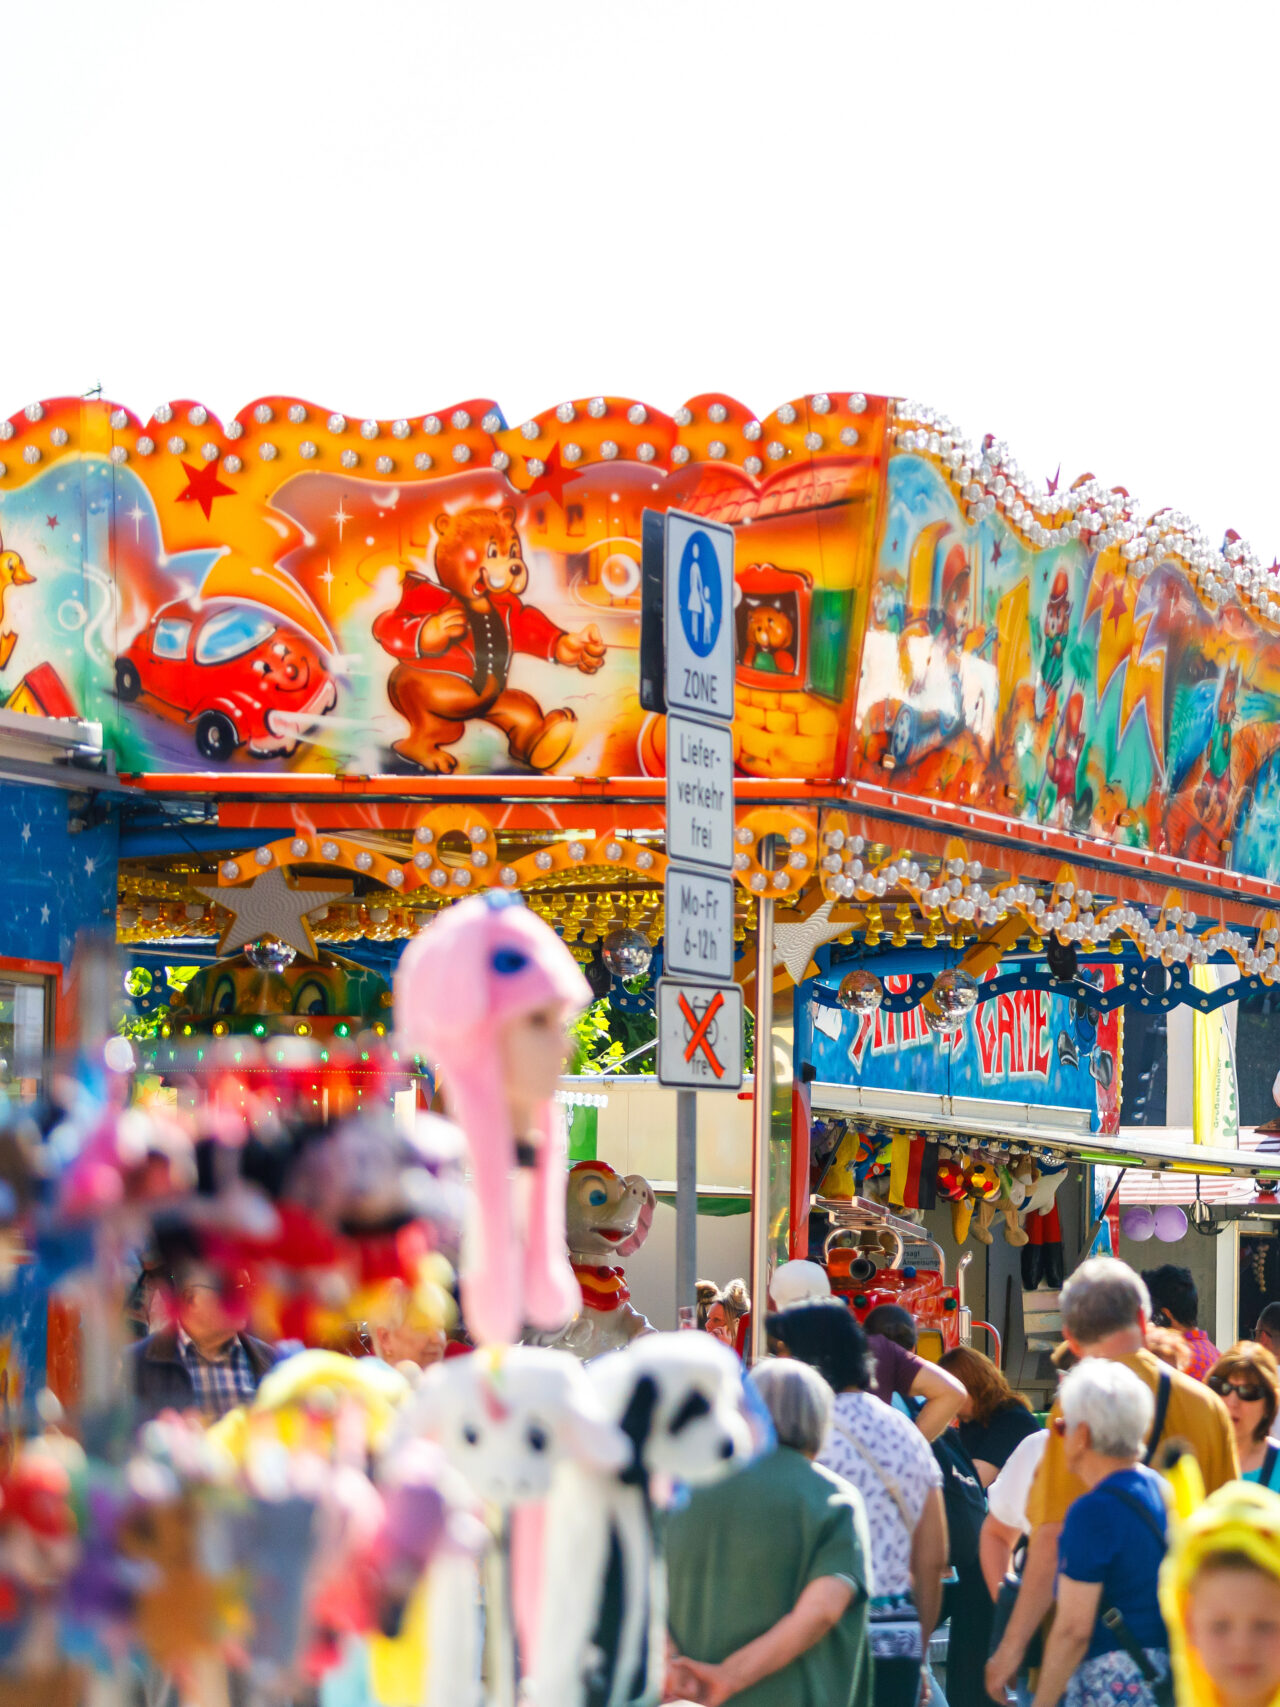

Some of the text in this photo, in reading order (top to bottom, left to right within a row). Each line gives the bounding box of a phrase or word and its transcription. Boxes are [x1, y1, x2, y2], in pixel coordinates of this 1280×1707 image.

[683, 668, 718, 704] ZONE
[680, 733, 721, 769] Liefer-
[677, 778, 725, 811] verkehr
[691, 817, 713, 849] frei
[680, 884, 720, 920] Mo-Fr
[683, 927, 718, 961] 6-12h
[973, 964, 1053, 1083] GAME
[691, 1054, 710, 1076] fre
